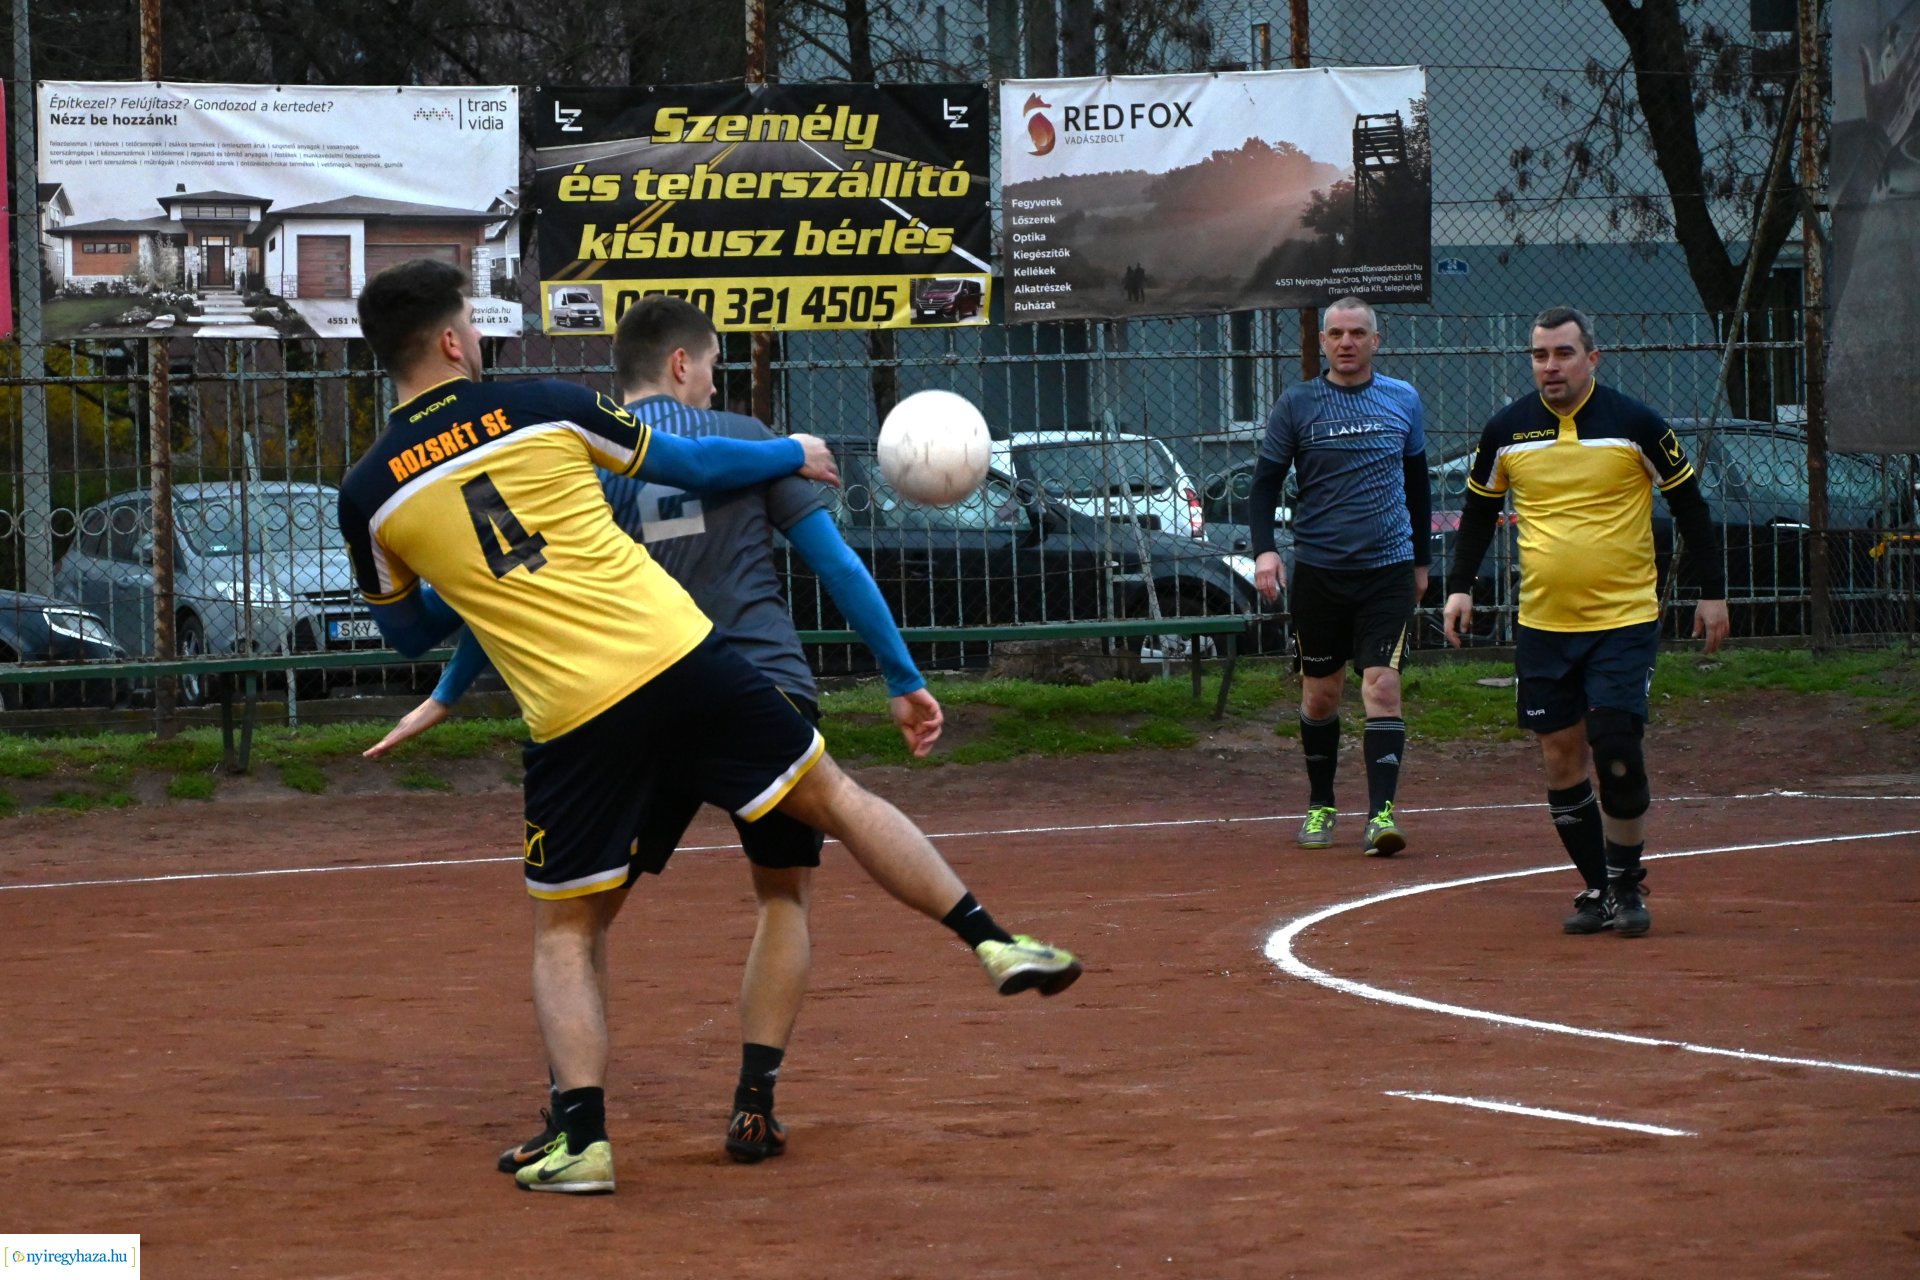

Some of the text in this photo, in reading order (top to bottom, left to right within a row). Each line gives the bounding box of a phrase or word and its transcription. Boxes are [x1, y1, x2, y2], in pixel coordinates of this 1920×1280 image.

[49, 94, 333, 112] Építkezel? Felújítasz? Gondozod a kertedet?
[467, 98, 507, 112] trans
[50, 113, 177, 126] Nézz be hozzánk!
[468, 116, 504, 130] vidia
[651, 104, 879, 151] Személy
[1065, 134, 1125, 144] VADÁSZBOLT
[557, 160, 970, 202] és teherszállító
[1011, 197, 1063, 209] Fegyverek
[1012, 214, 1056, 225] Lőszerek
[577, 219, 955, 261] kisbusz bérlés
[1012, 232, 1046, 244] Optika
[1013, 247, 1071, 260] Kiegészítők
[1013, 266, 1056, 277] Kellékek
[1331, 264, 1423, 274] www.redfoxvadaszbolt.hu
[1014, 282, 1072, 294] Alkatrészek
[1275, 278, 1293, 286] 4551
[724, 287, 789, 325] 321
[801, 285, 898, 323] 4505
[1014, 301, 1056, 311] Ruházat
[327, 317, 348, 325] 4551
[486, 316, 496, 324] út
[498, 316, 512, 324] 19.
[409, 394, 457, 423] GIVOVA
[1512, 429, 1555, 440] GIVOVA
[387, 408, 512, 483] ROZSRÉT SE
[460, 471, 548, 579] 4
[341, 623, 378, 637] SKY-
